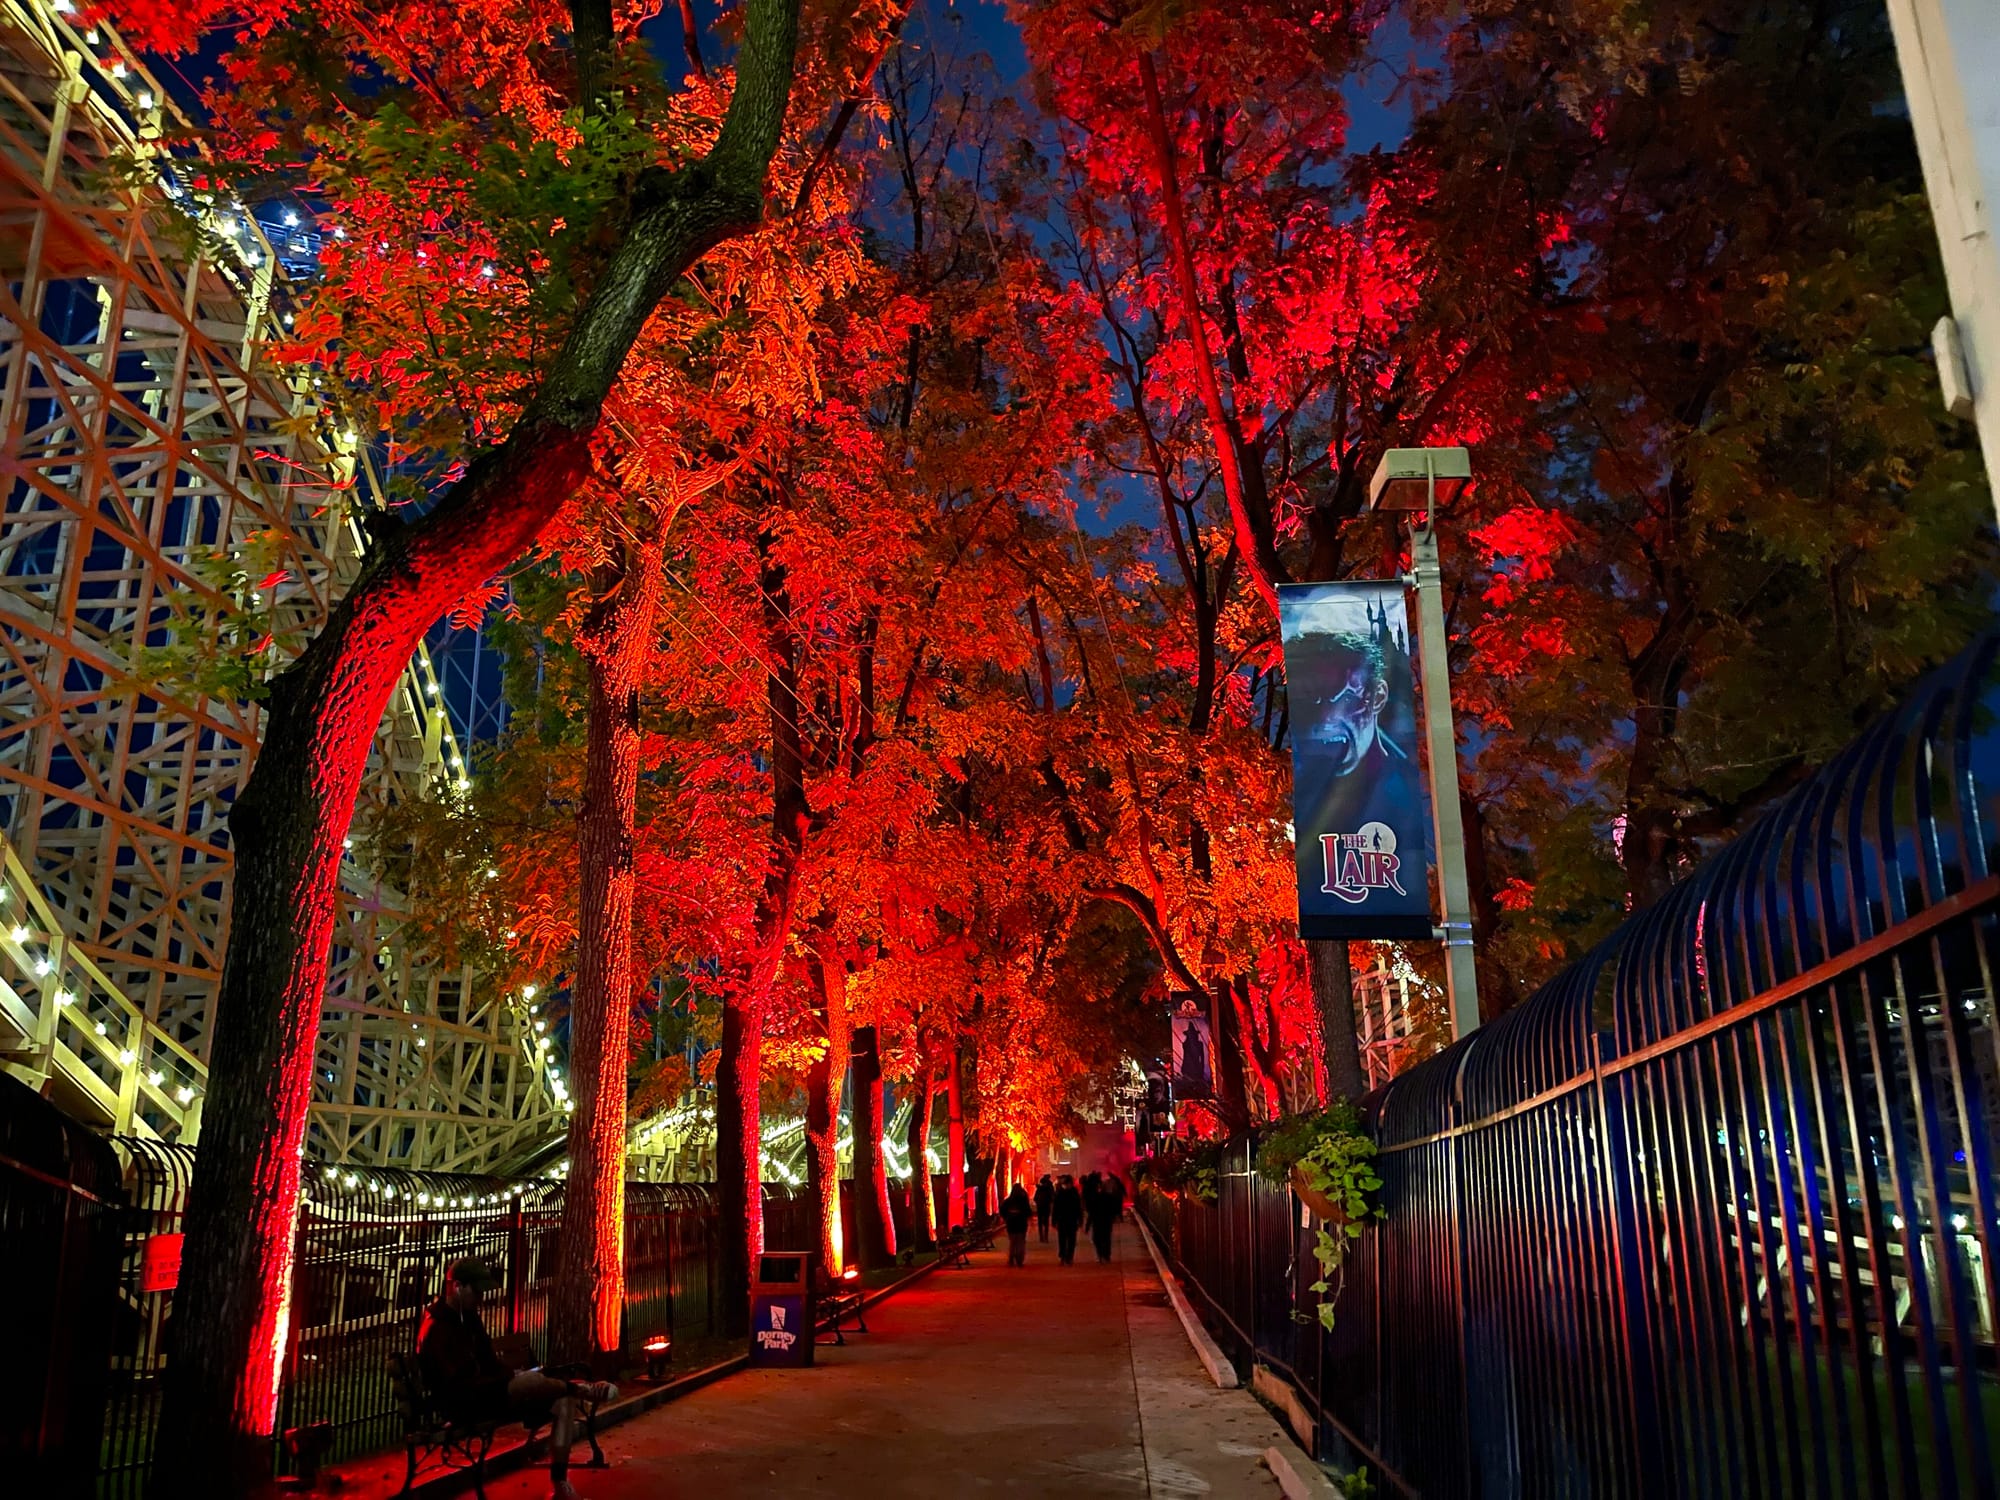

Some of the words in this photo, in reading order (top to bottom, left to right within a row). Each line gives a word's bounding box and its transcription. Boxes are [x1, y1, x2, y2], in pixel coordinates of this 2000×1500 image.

[1341, 834, 1368, 849] THE
[1319, 834, 1406, 903] LAIR
[157, 1271, 179, 1283] ENTE
[757, 1331, 796, 1345] Dorney
[764, 1340, 789, 1351] Park
